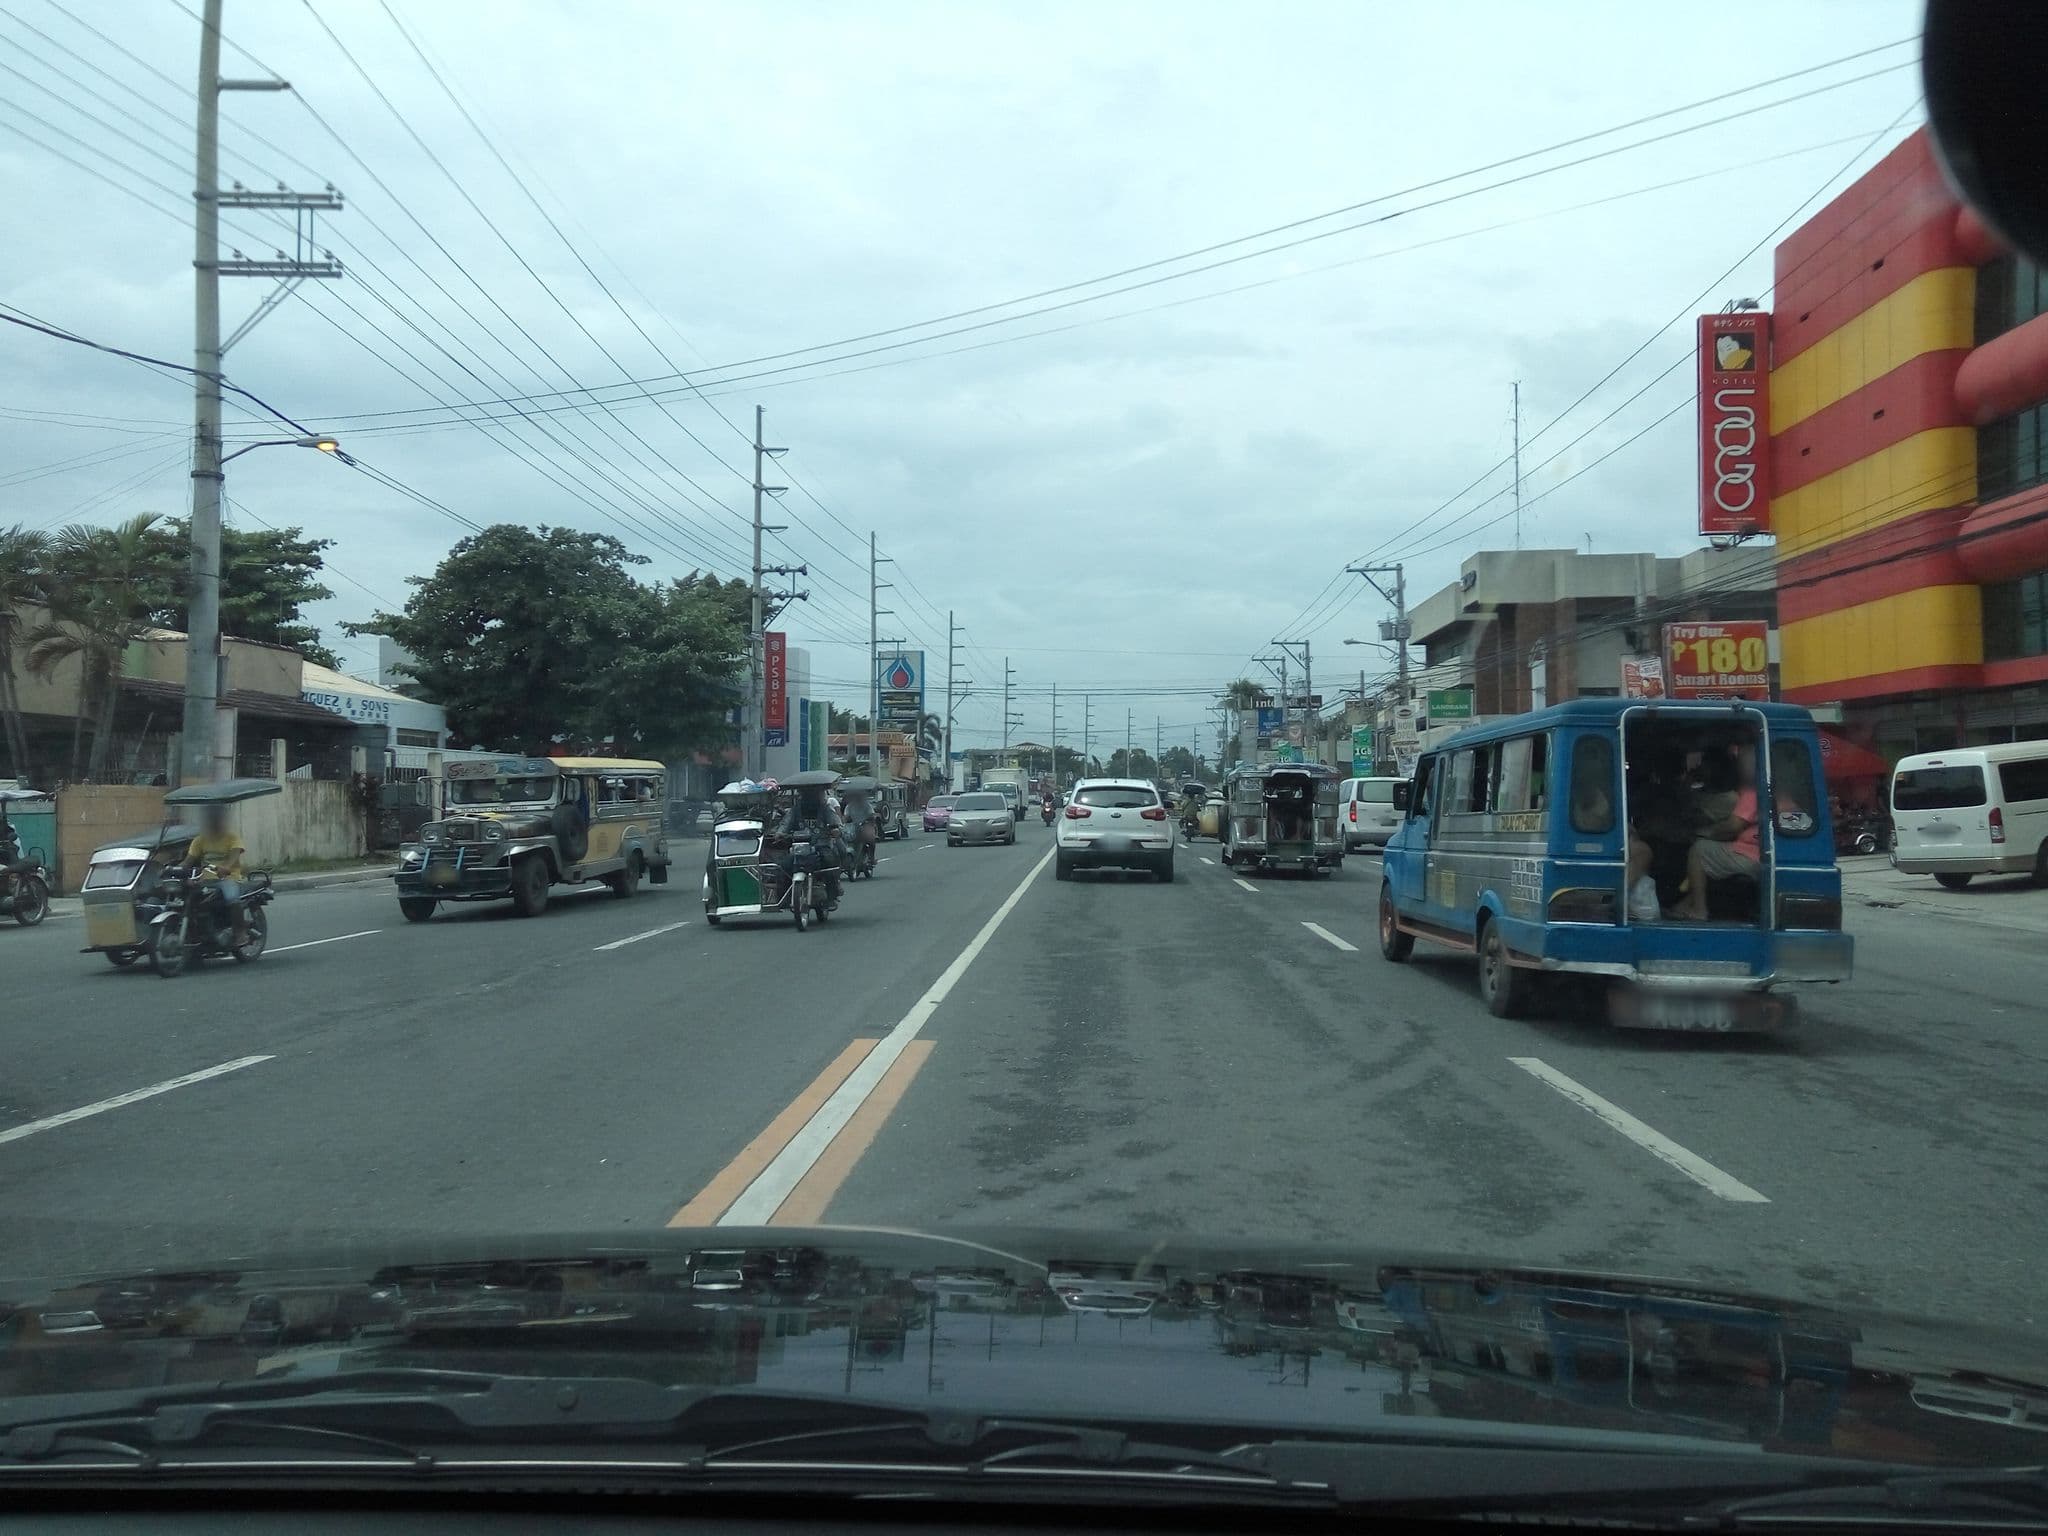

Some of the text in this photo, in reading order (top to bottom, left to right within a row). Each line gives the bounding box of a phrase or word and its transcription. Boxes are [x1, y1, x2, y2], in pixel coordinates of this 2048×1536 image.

[1714, 388, 1756, 512] SOGO
[1673, 626, 1697, 639] Try
[771, 655, 780, 716] PSBank
[1675, 673, 1767, 686] Smart Rooms
[361, 699, 389, 713] SONS
